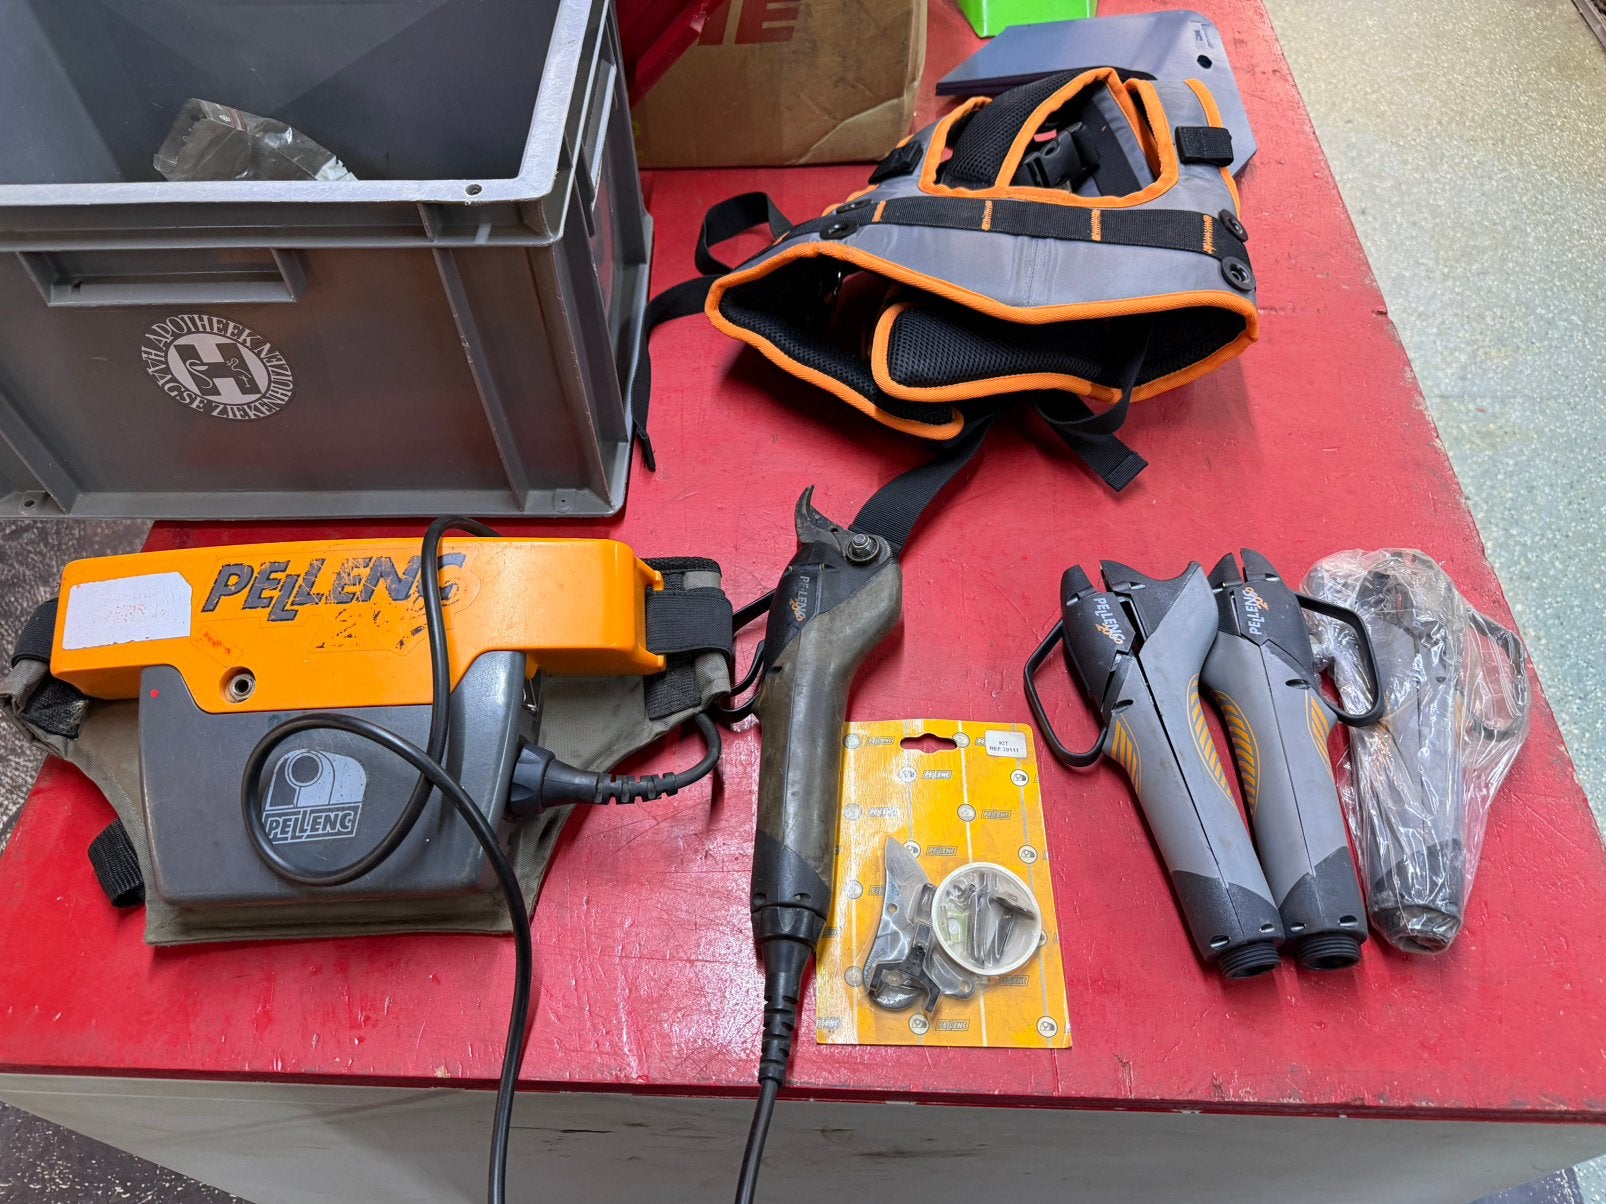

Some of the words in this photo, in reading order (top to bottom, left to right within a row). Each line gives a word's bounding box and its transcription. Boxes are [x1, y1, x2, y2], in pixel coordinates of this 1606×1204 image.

[145, 314, 263, 350] APOTHEEK
[141, 345, 207, 412] HAAGSE
[210, 342, 294, 420] ZIEKENHUIZEN
[266, 808, 355, 842] PELLENC
